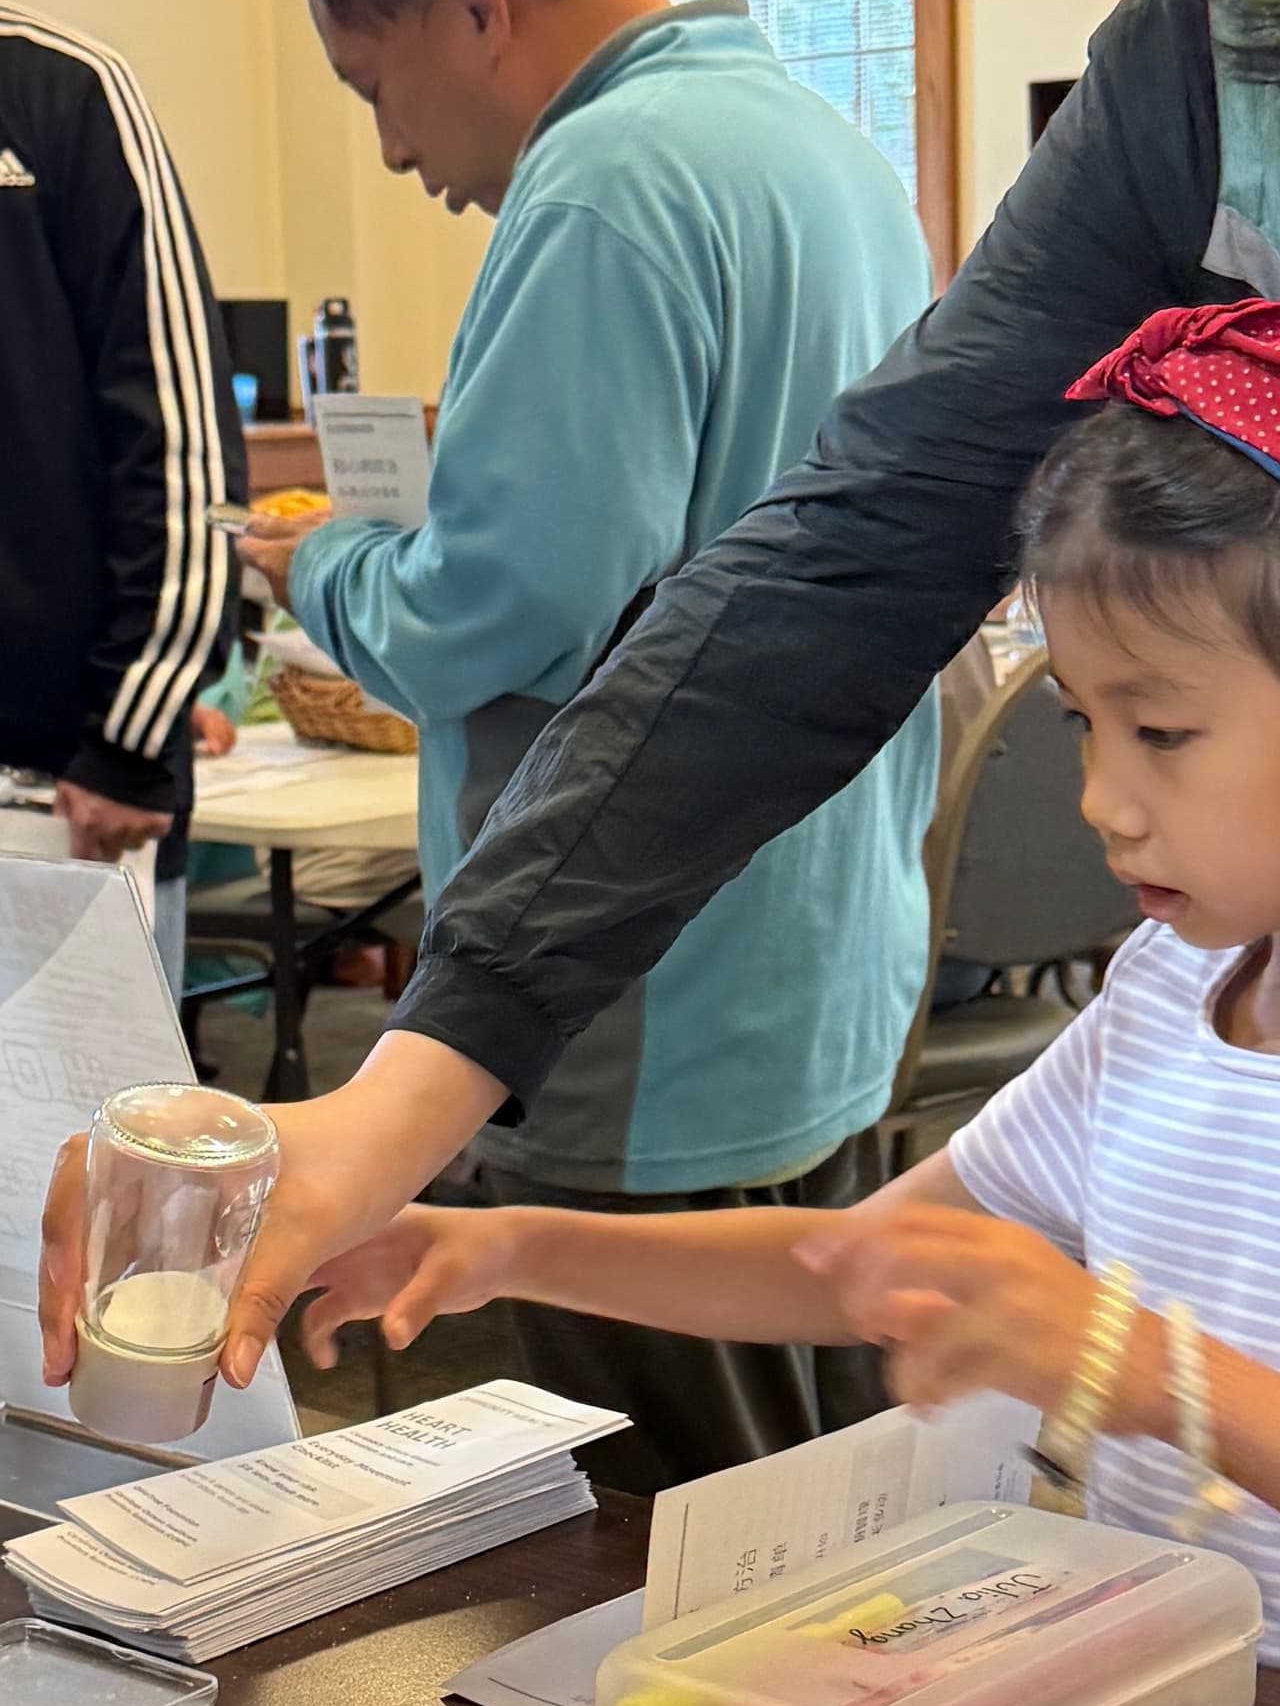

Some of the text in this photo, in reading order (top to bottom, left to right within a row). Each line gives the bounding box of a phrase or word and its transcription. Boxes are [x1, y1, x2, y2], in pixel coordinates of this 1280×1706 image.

[375, 1421, 456, 1449] HEALTH
[402, 1412, 472, 1436] HEART
[848, 1573, 1053, 1645] Julia Zhang
